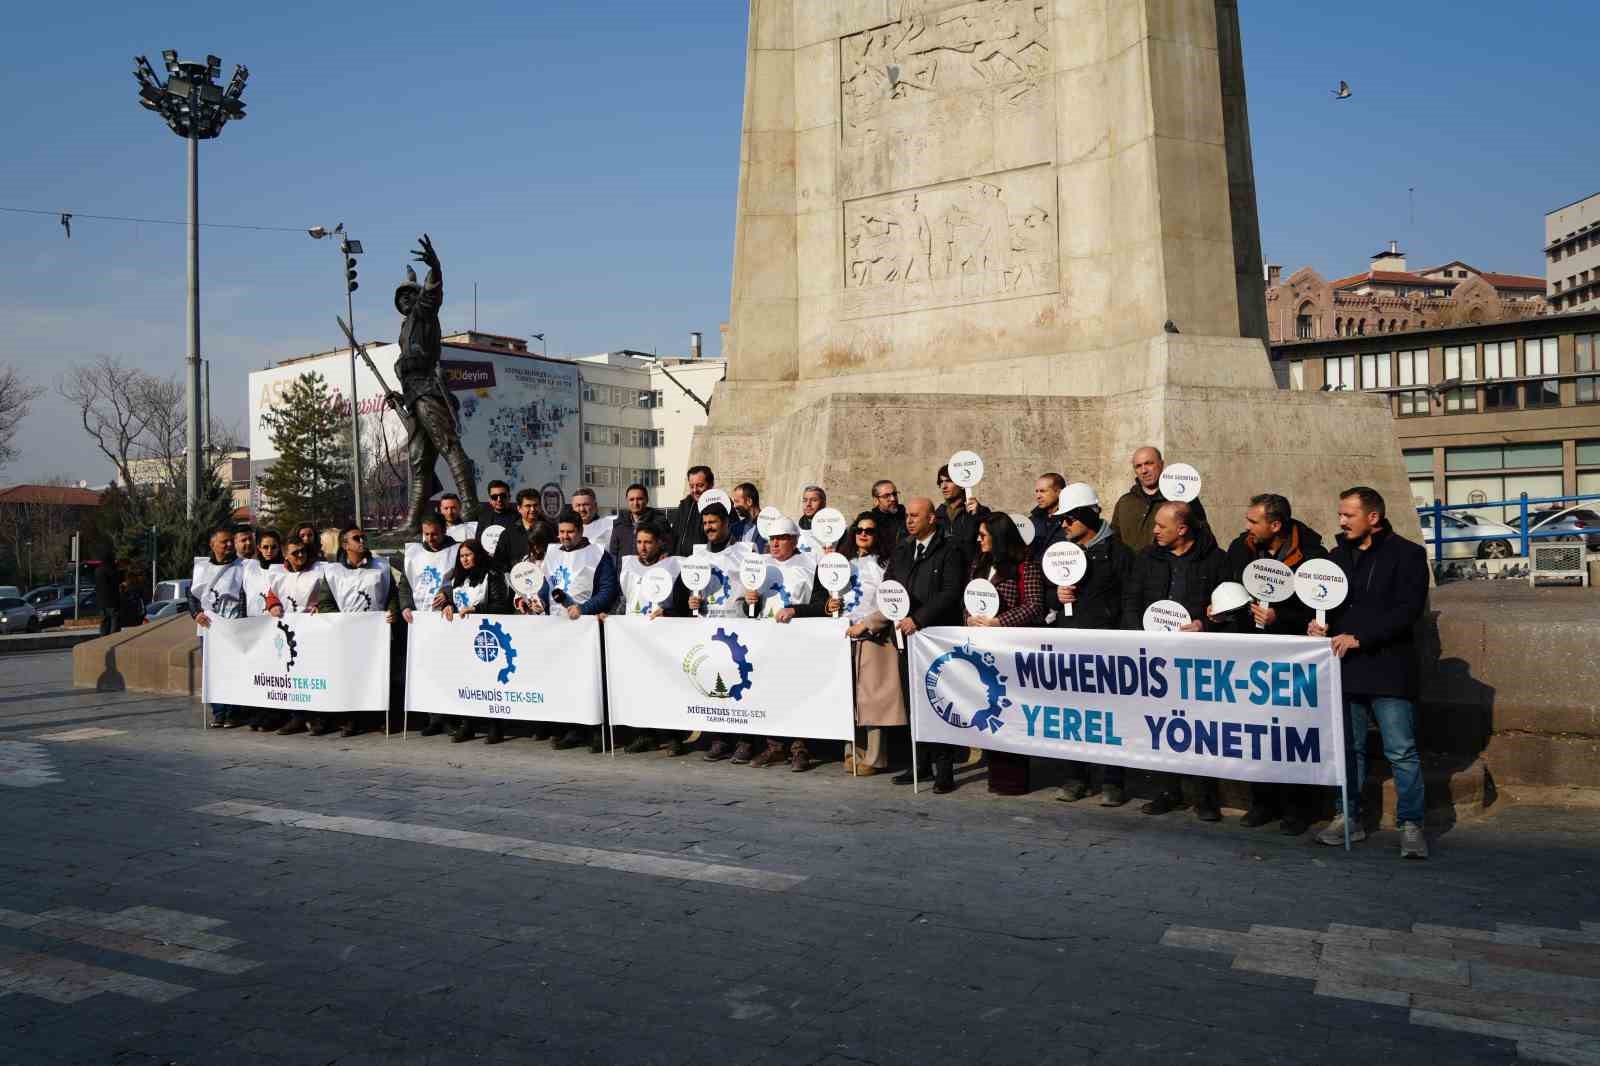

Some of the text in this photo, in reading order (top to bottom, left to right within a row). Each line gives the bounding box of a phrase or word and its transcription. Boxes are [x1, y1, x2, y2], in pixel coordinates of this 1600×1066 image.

[254, 672, 291, 689] MÜHENDİS
[1014, 645, 1319, 708] MÜHENDİS TEK-SEN
[458, 686, 544, 704] MÜHENDİS TEK-SEN
[489, 703, 511, 714] BÜRO
[1021, 704, 1321, 764] YEREL YÖNETİM
